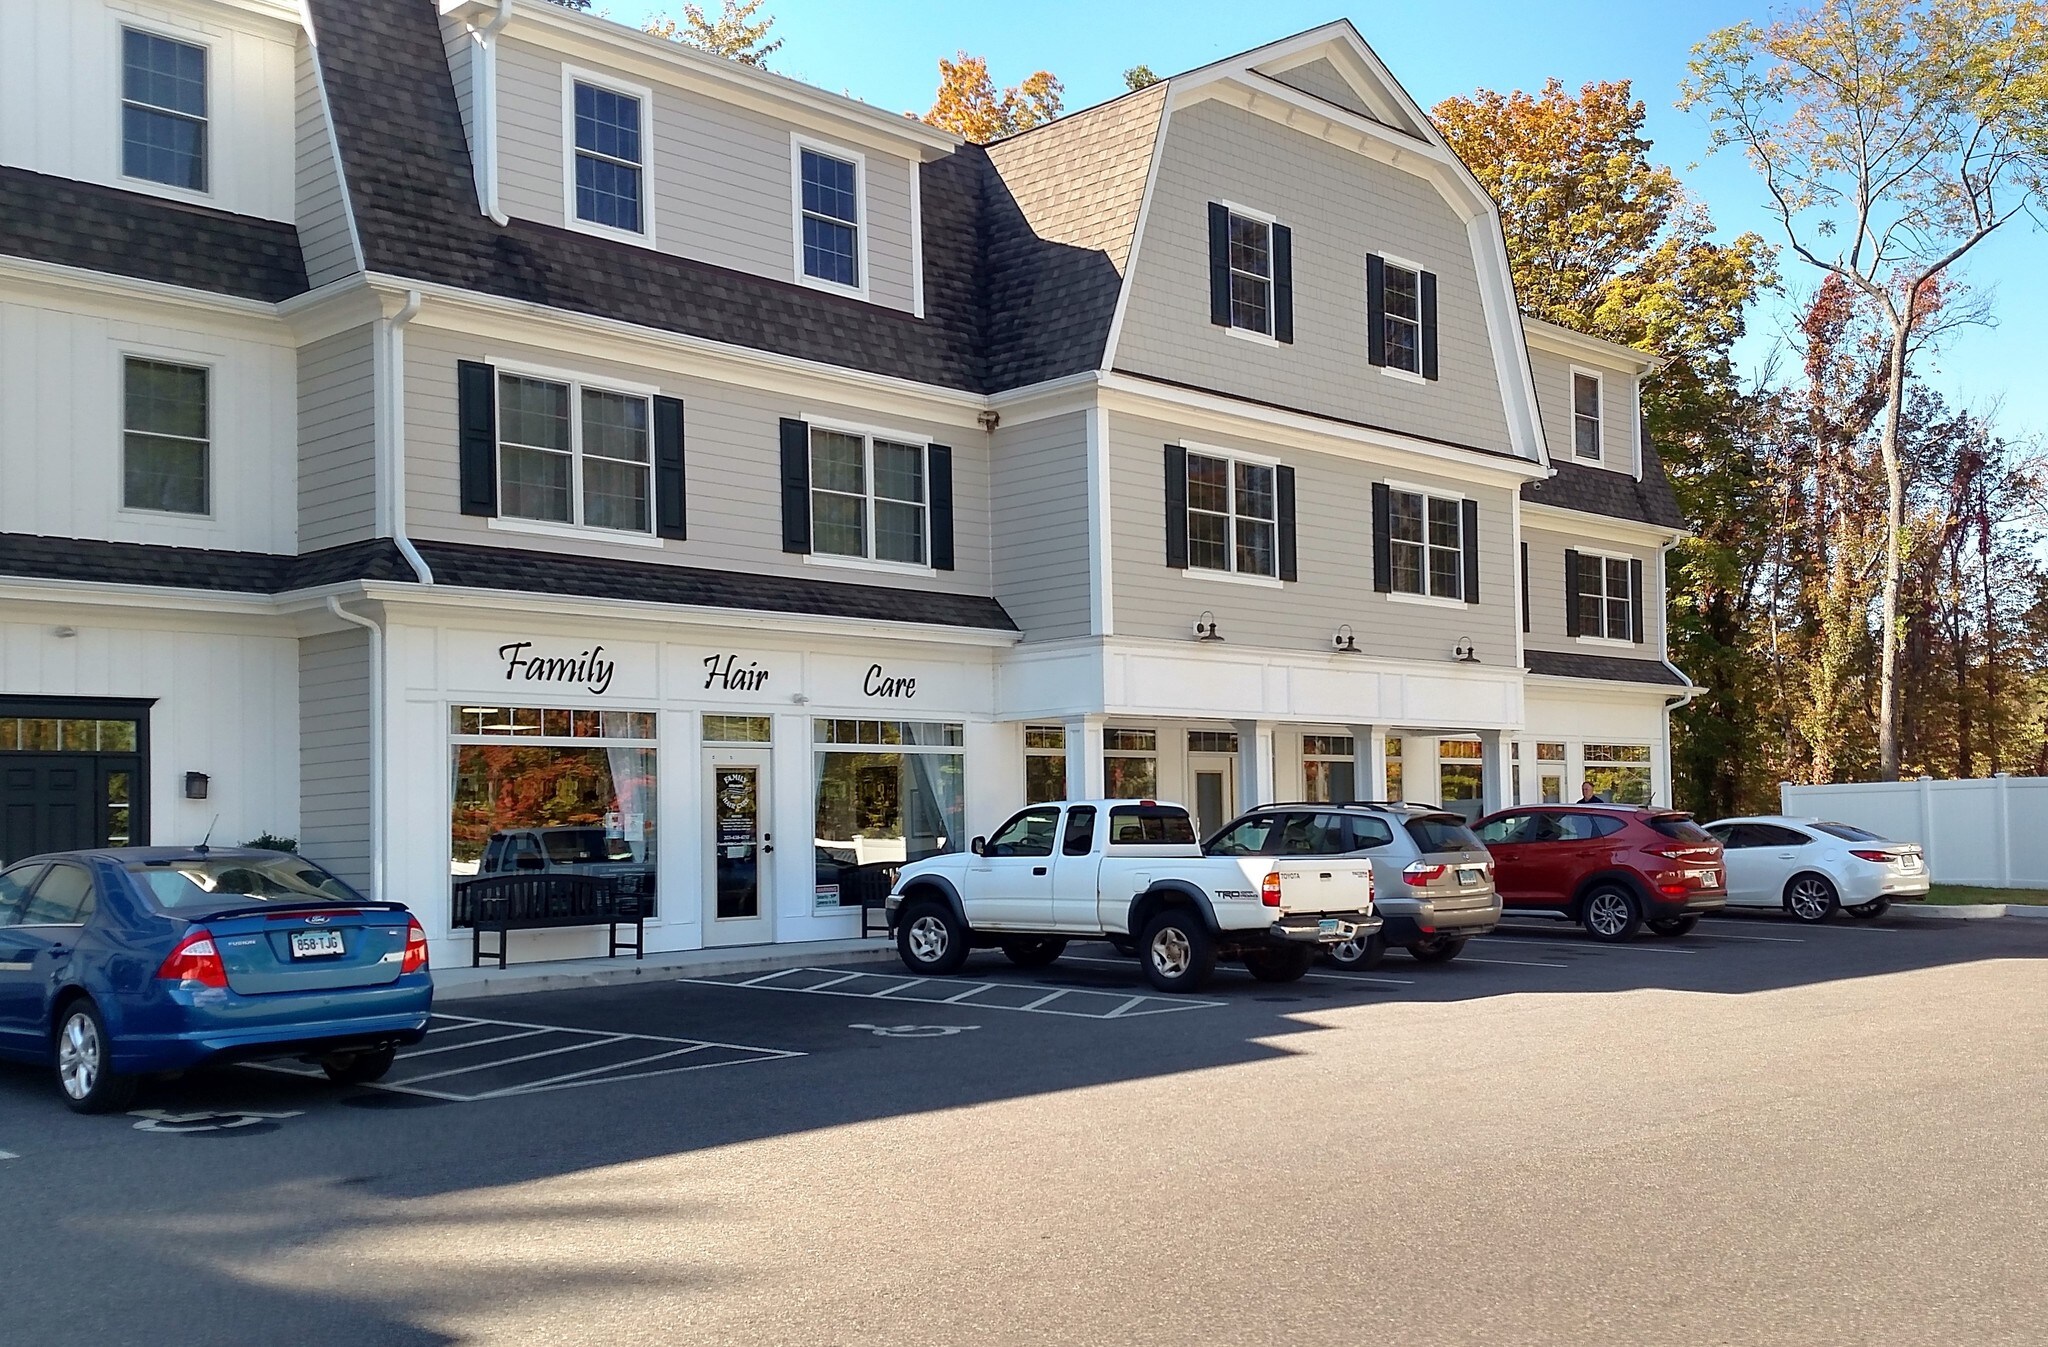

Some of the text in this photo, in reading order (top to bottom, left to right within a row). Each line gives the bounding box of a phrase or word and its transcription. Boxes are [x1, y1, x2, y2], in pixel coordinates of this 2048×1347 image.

[498, 641, 916, 699] Family Hair Care
[723, 774, 748, 784] FAMILY
[1281, 872, 1301, 880] TOYOTA
